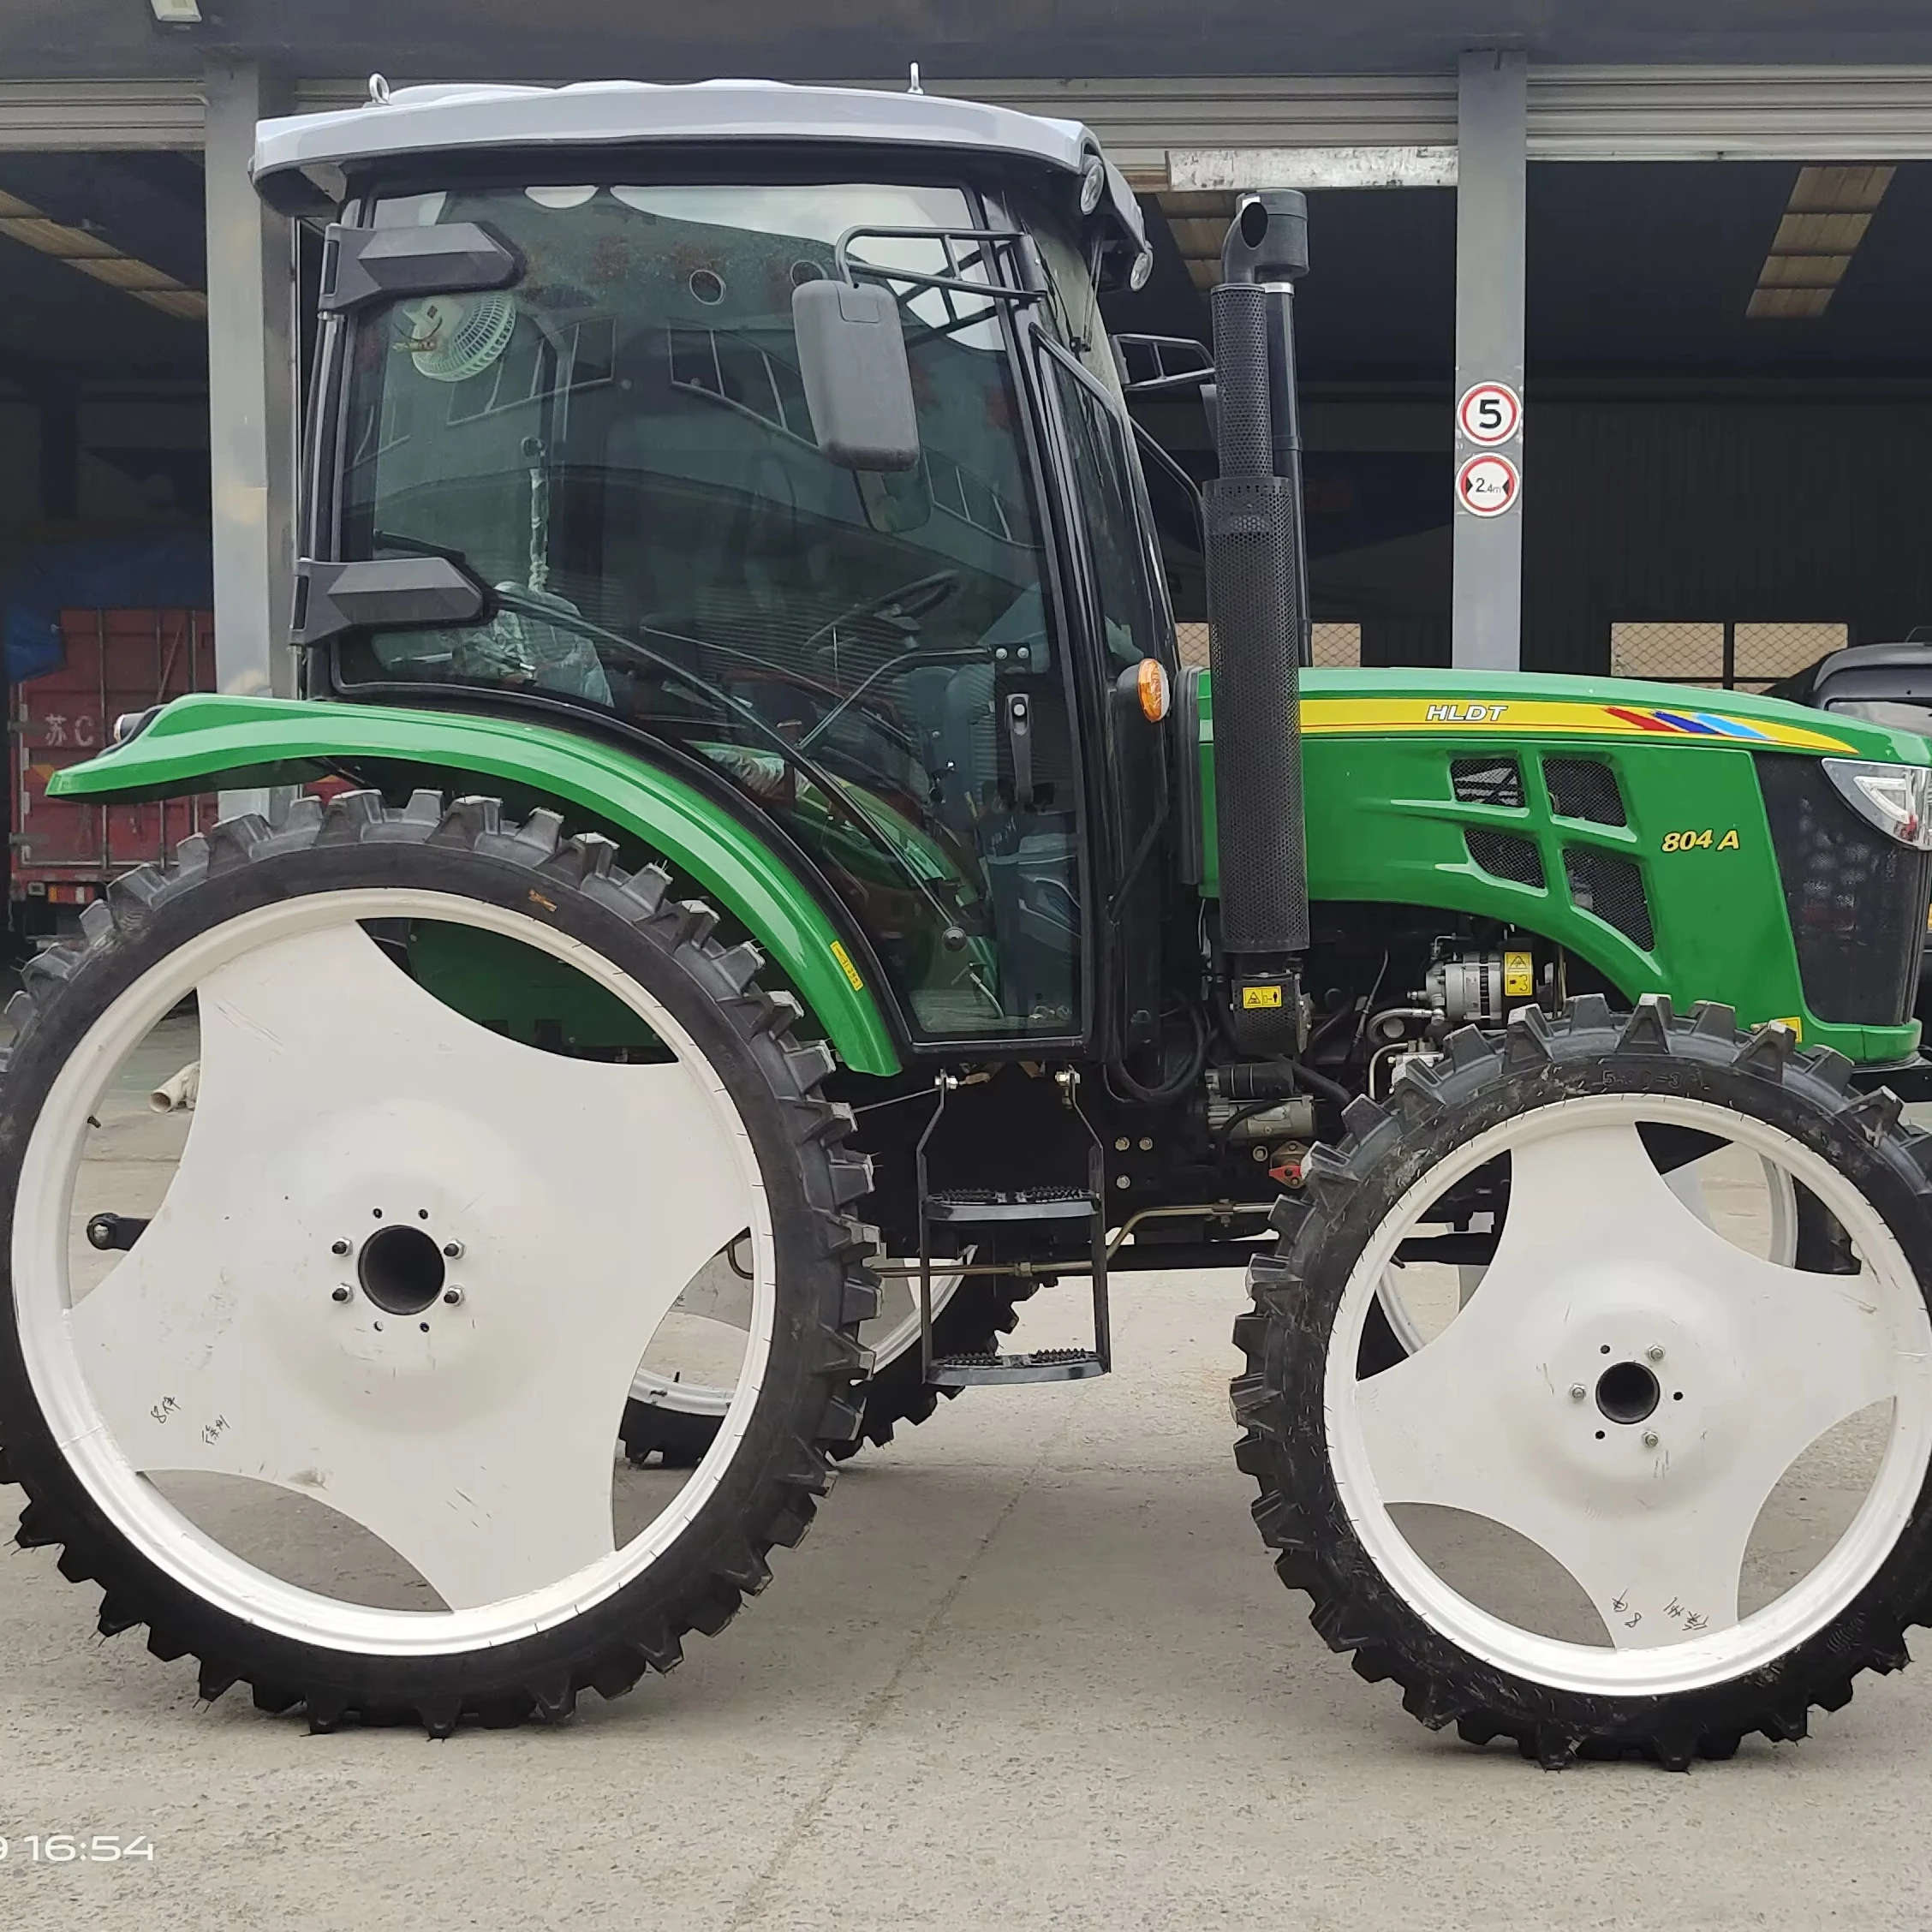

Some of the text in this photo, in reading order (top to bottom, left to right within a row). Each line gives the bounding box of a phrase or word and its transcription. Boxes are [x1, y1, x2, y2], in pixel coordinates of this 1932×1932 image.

[1479, 399, 1502, 429] 5
[1476, 477, 1501, 493] 2.4m
[1425, 704, 1509, 721] HLDT
[1661, 828, 1740, 853] 804 A
